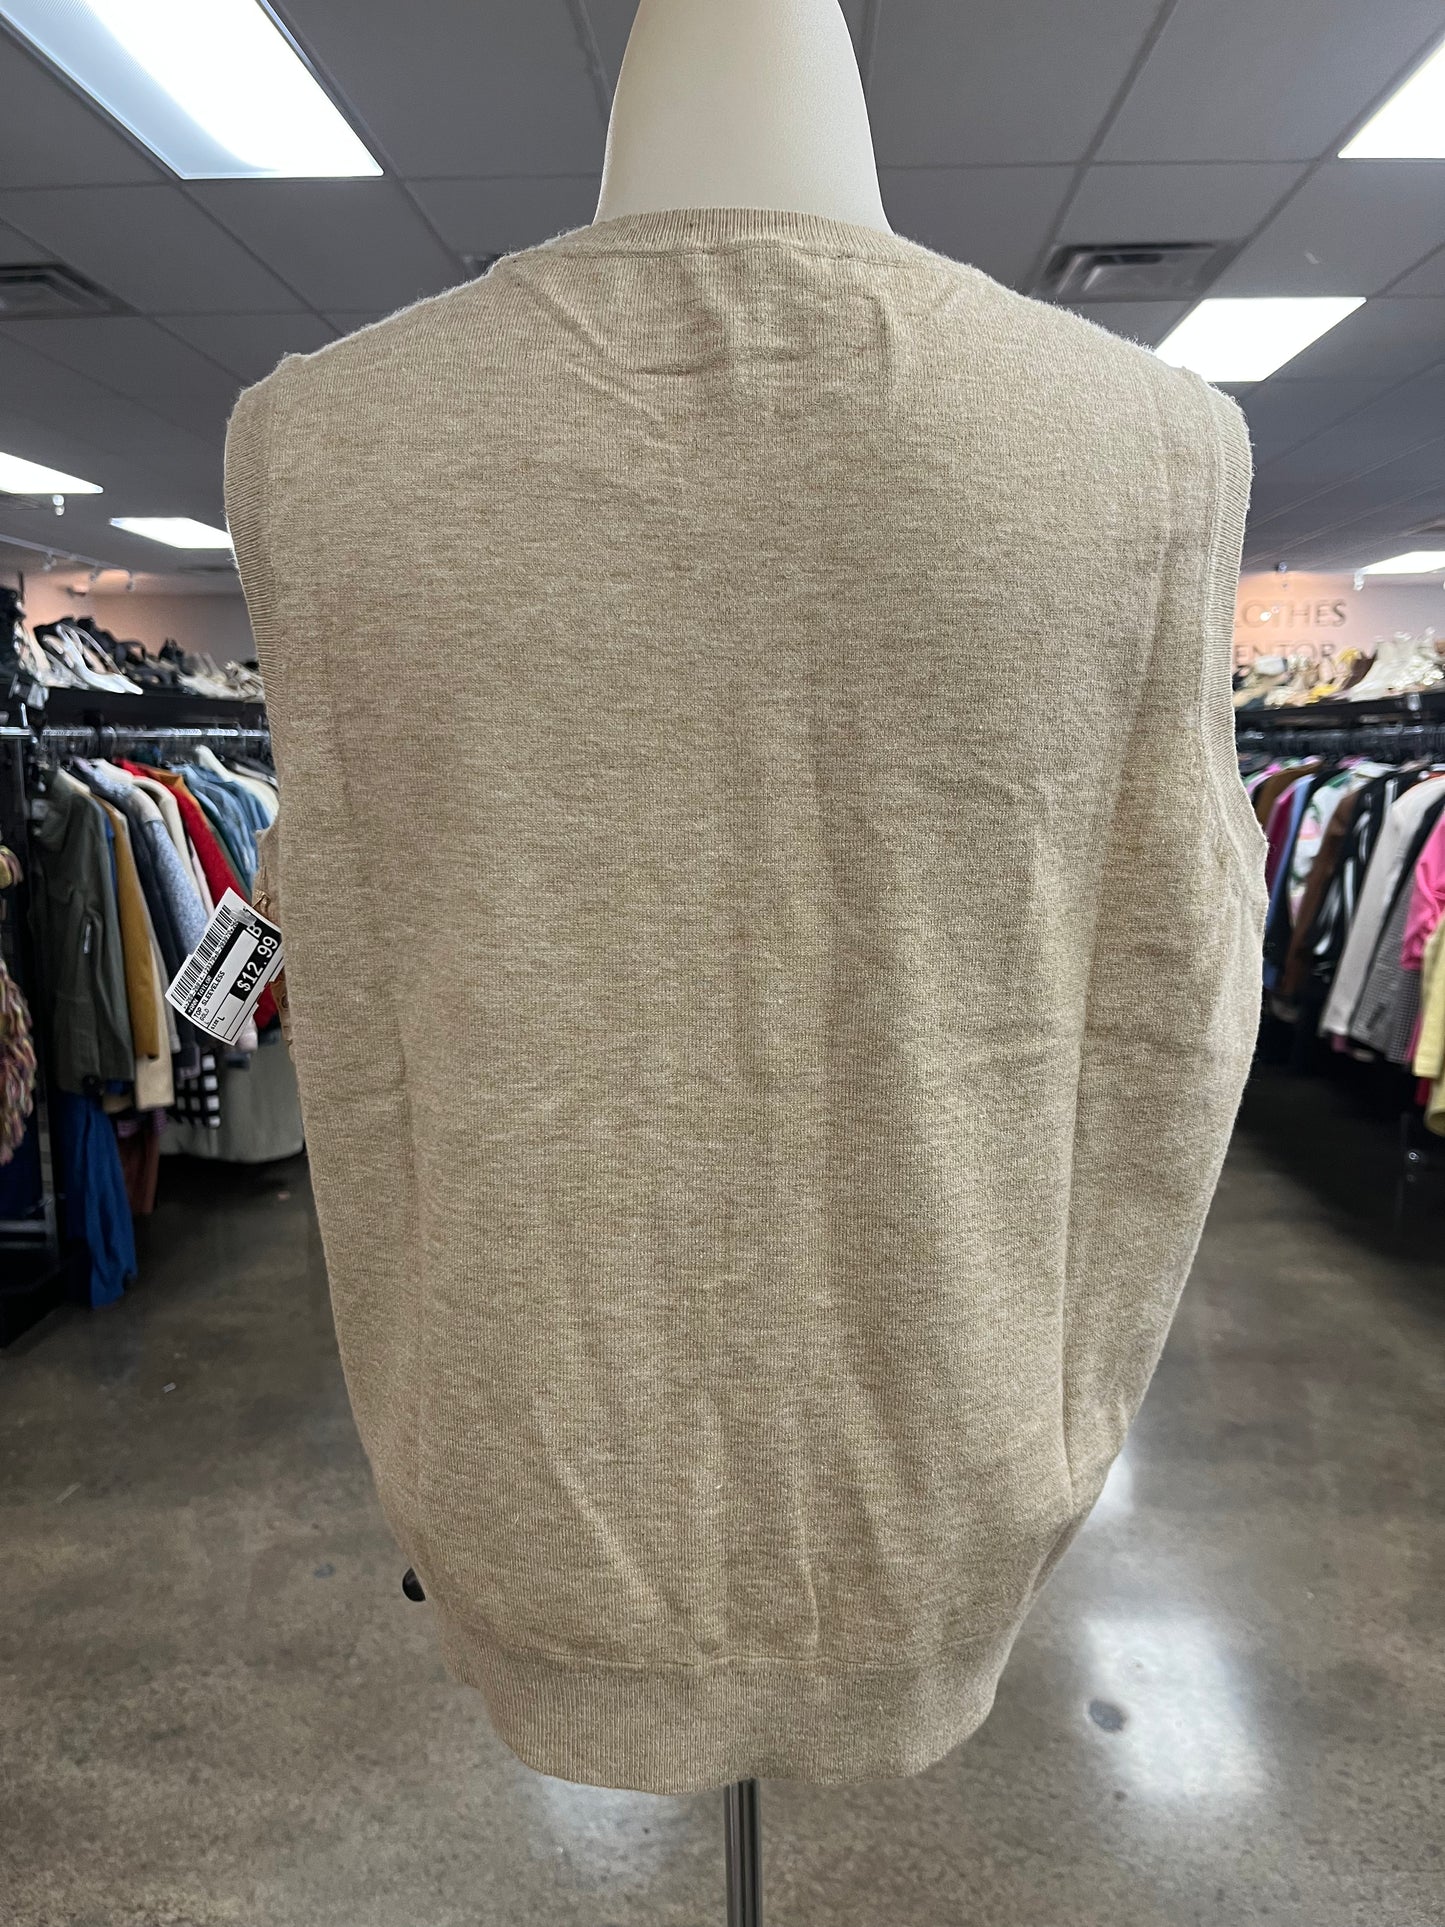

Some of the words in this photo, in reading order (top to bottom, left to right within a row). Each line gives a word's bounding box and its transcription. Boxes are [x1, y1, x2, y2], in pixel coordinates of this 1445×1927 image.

[1235, 599, 1346, 628] OTHES
[237, 936, 278, 992] $12.99
[193, 1007, 201, 1018] TOP
[201, 971, 225, 1006] SLEEVELESS
[197, 975, 212, 997] TAYLOR
